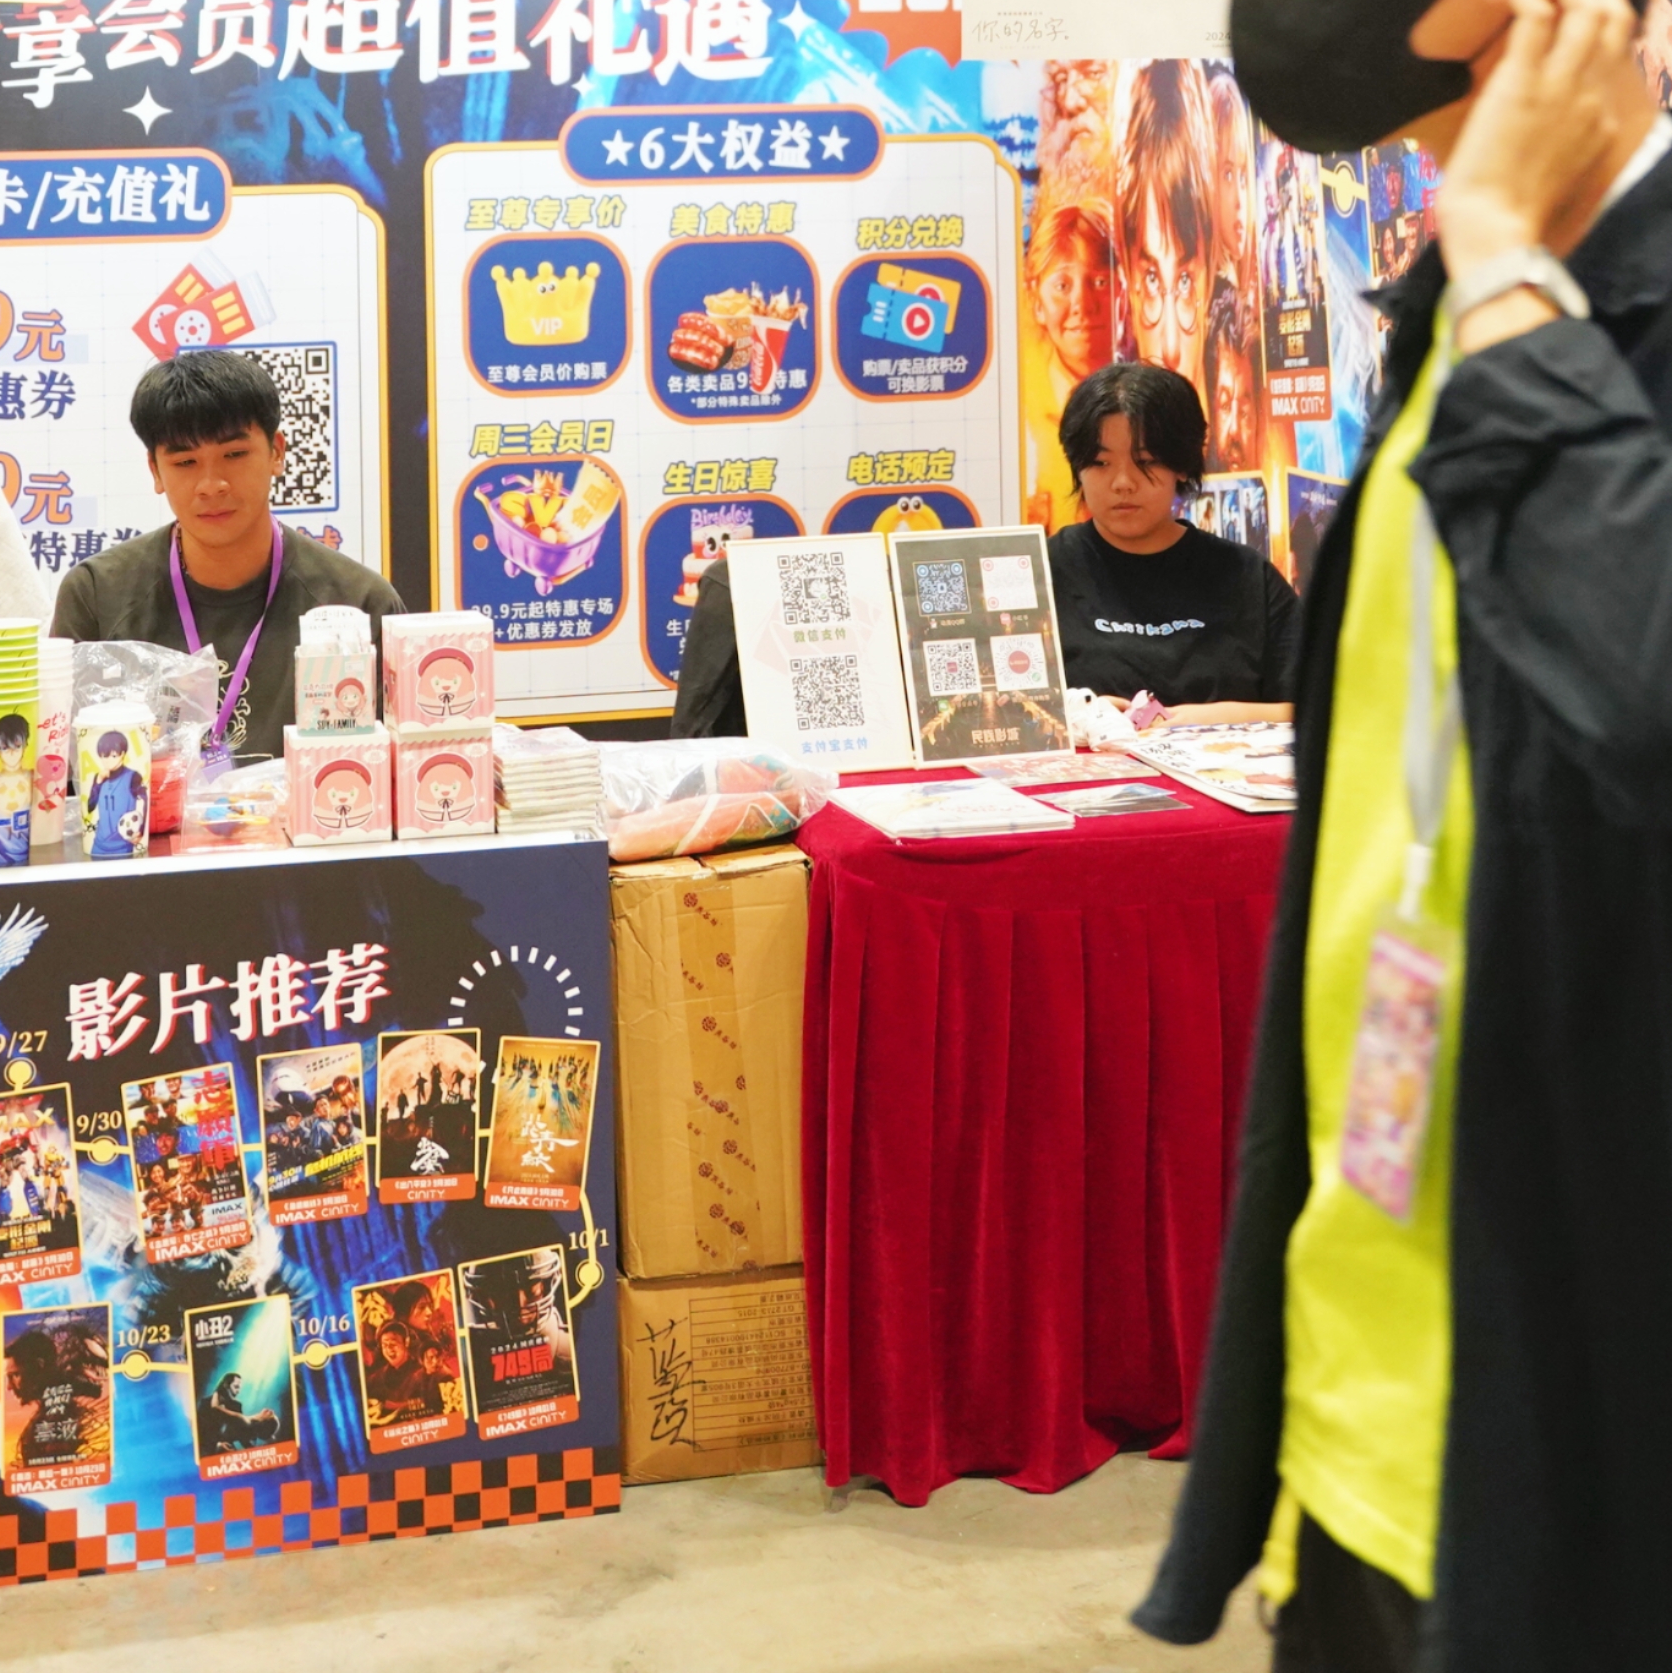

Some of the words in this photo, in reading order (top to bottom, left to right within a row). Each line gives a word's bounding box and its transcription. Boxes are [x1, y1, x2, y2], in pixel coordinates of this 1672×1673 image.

[465, 194, 627, 231] 至尊专享价
[669, 200, 797, 238] 美食特惠
[856, 214, 964, 250] 积分兑换
[530, 316, 563, 337] VIP
[487, 361, 608, 384] 至尊会员价购票
[862, 354, 969, 377] 购票/卖品获积分
[667, 368, 808, 394] 各类卖品9特惠
[1271, 396, 1299, 417] IMAX
[469, 419, 615, 459] 周三会员日
[662, 457, 778, 495] 生日惊喜
[846, 448, 956, 486] 电话预定
[793, 628, 848, 643] 微信支付
[801, 737, 870, 755] 支付宝支付
[65, 941, 391, 1062] 影片推荐
[76, 1110, 123, 1136] 9/30
[407, 1189, 446, 1201] CINITY
[490, 1195, 529, 1206] IMAX
[531, 1197, 570, 1208] CINITY
[276, 1208, 317, 1224] IMAX
[321, 1202, 360, 1218] CINITY
[155, 1239, 207, 1261] IMAX
[207, 1231, 248, 1250] CINITY
[31, 1262, 74, 1279] CINITY
[117, 1325, 171, 1349] 10/23
[298, 1314, 350, 1338] 10/16
[491, 1344, 554, 1382] 749局
[486, 1419, 528, 1438] IMAX
[529, 1410, 567, 1428] CINITY
[400, 1429, 440, 1446] CINITY
[207, 1460, 253, 1477] IMAX
[253, 1452, 293, 1469] CINITY
[11, 1479, 58, 1495] IMAX
[60, 1474, 101, 1488] CINITY
